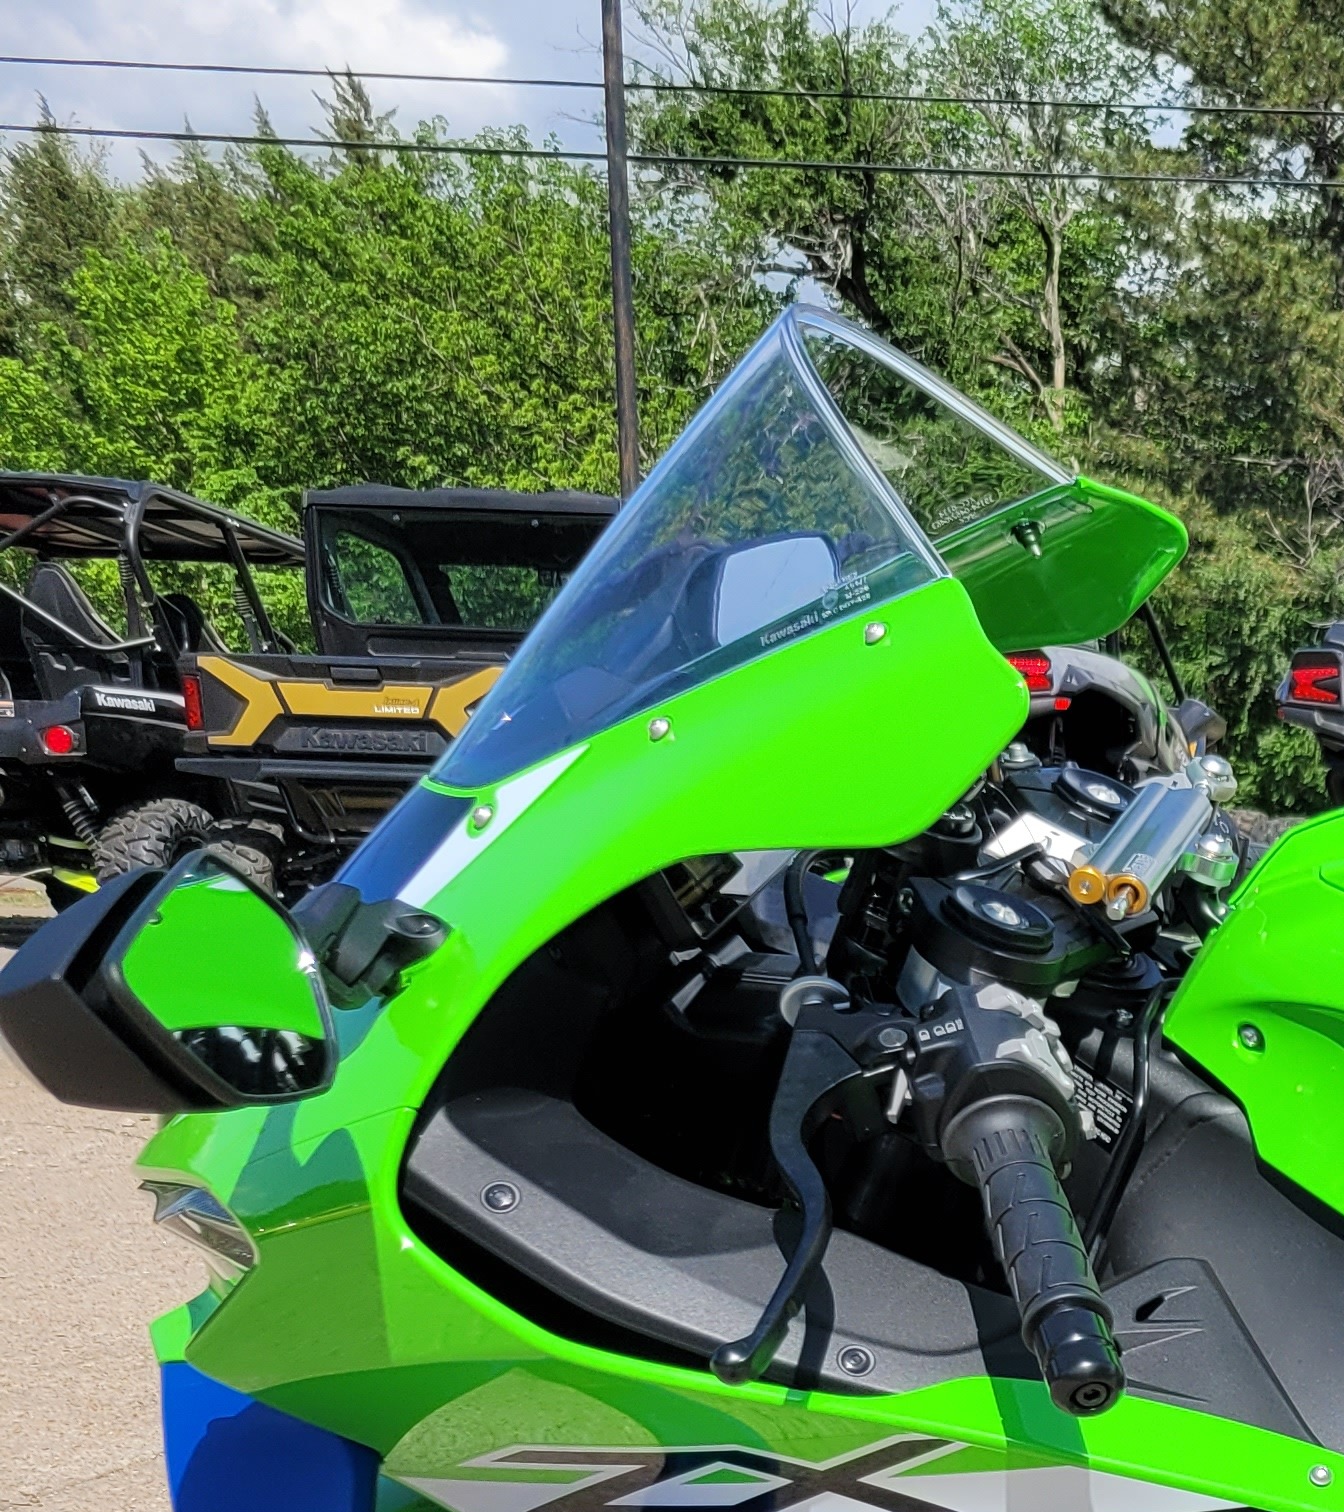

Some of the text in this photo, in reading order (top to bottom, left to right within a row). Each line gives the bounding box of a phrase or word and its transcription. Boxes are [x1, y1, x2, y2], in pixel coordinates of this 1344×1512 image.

[760, 610, 819, 647] Kawasaki
[95, 693, 156, 713] Kawasaki
[373, 705, 420, 714] LIMITED
[301, 727, 427, 752] Kawasaki
